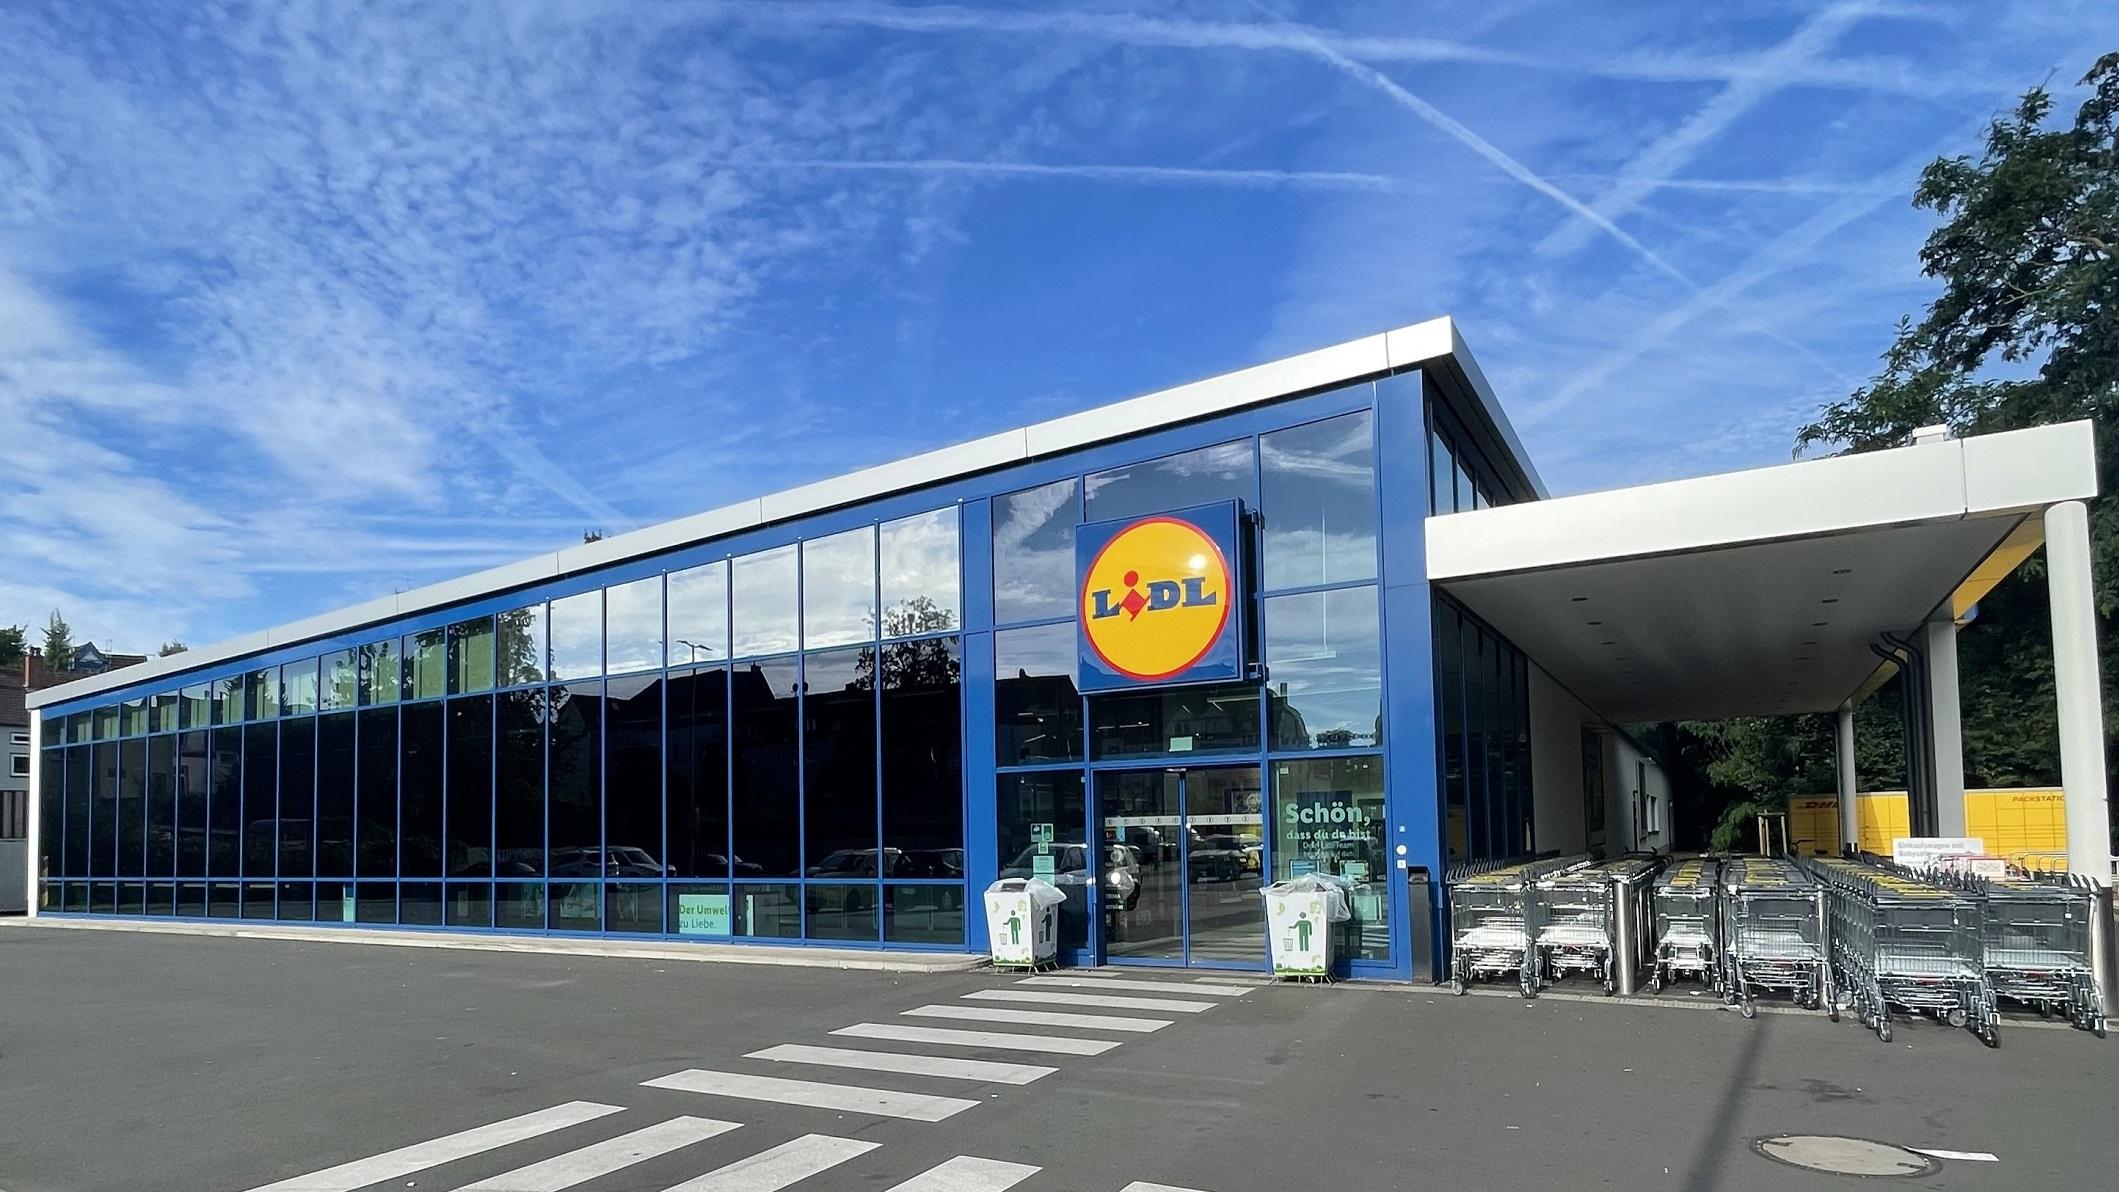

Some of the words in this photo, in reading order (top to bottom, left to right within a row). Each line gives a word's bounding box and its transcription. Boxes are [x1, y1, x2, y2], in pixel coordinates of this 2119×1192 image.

[1286, 802, 1370, 826] Schön,
[1286, 830, 1311, 839] dass
[1314, 829, 1329, 839] du
[679, 905, 695, 914] Der
[697, 905, 729, 915] Umwel
